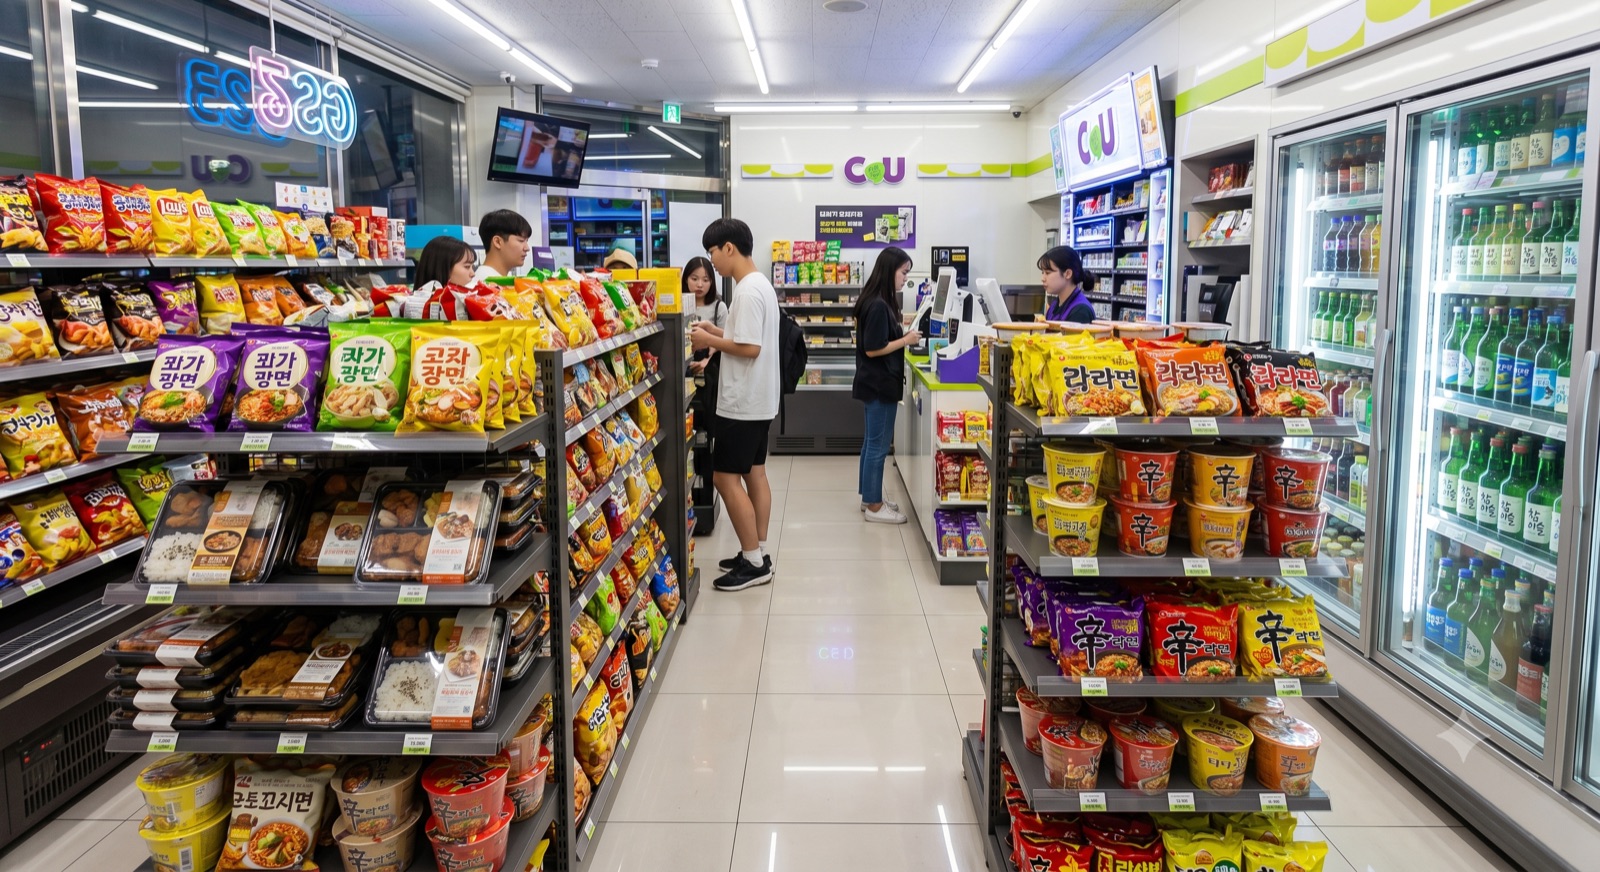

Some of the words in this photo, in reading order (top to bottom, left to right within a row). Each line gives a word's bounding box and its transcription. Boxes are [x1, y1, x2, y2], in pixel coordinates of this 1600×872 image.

[1077, 107, 1115, 166] CU
[843, 156, 906, 183] CU
[1137, 460, 1165, 495] 辛
[1212, 463, 1241, 499] 辛
[1273, 465, 1303, 500] 辛
[1130, 513, 1160, 548] 辛
[1071, 613, 1114, 672] 辛
[1163, 619, 1205, 676] 辛
[1255, 609, 1295, 664] 辛
[343, 798, 366, 832] 辛
[434, 798, 458, 833] 辛
